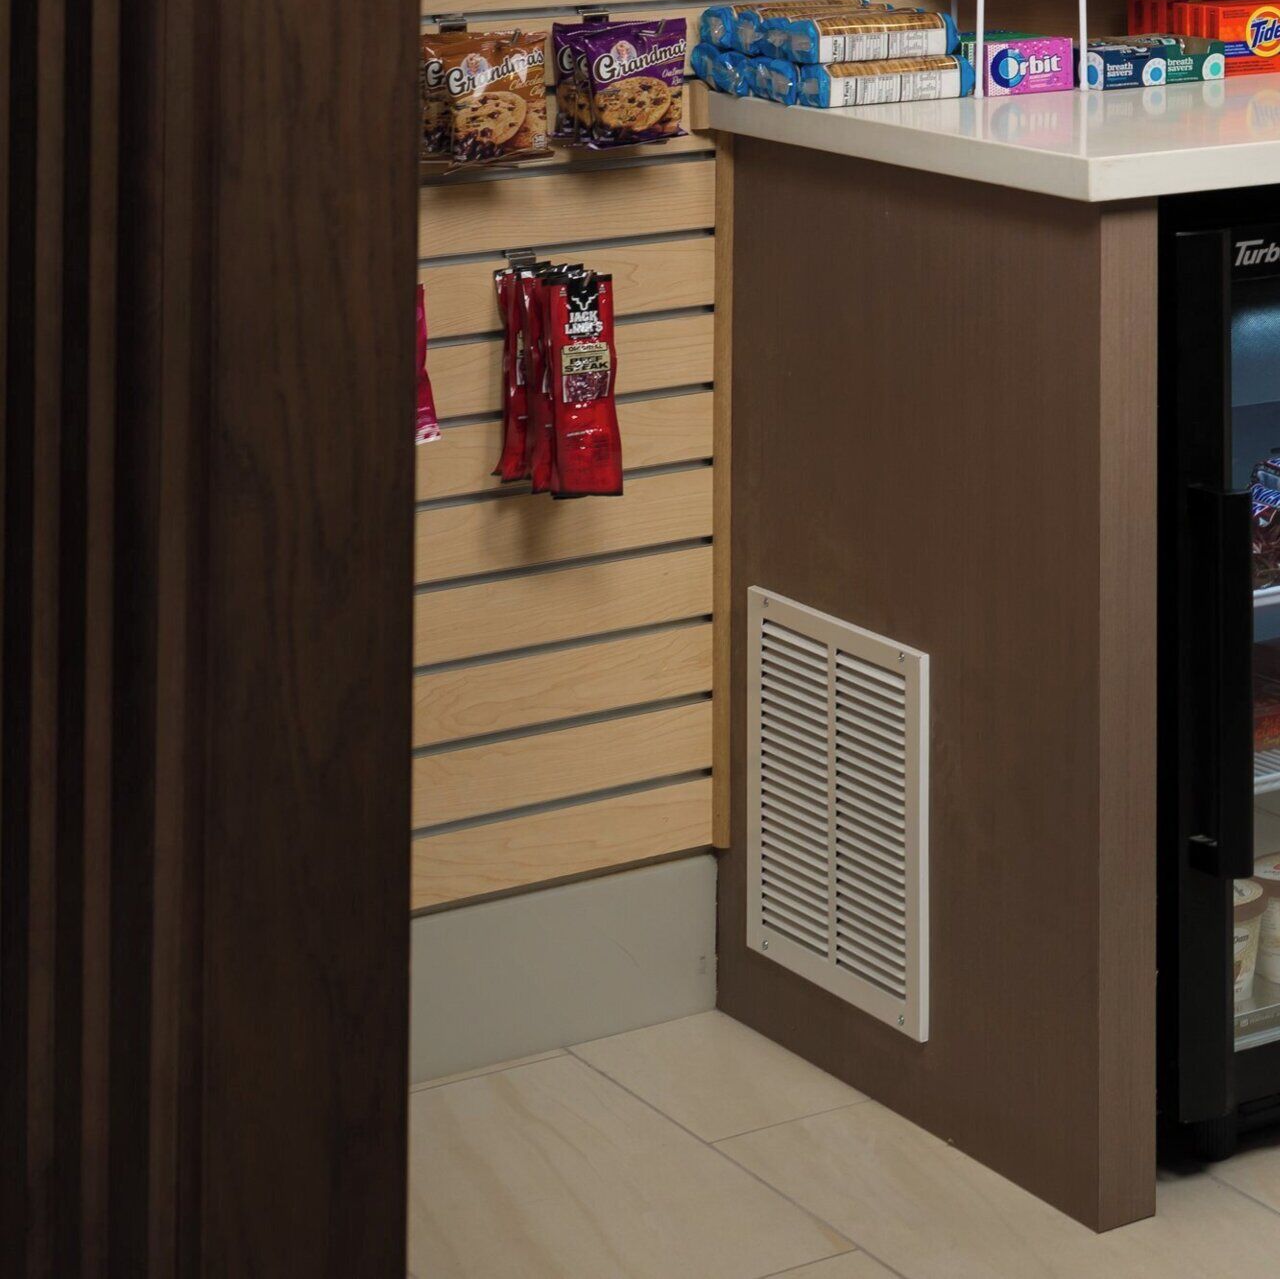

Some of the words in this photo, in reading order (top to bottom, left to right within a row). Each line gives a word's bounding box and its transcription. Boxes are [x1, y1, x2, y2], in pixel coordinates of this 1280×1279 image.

[593, 41, 687, 83] Grandma's
[1167, 57, 1194, 66] breath
[990, 48, 1062, 89] Orbit
[1106, 62, 1134, 71] breath
[1167, 64, 1194, 73] savers
[1107, 69, 1133, 78] savers
[569, 310, 598, 324] JACK
[570, 356, 603, 365] BEEF
